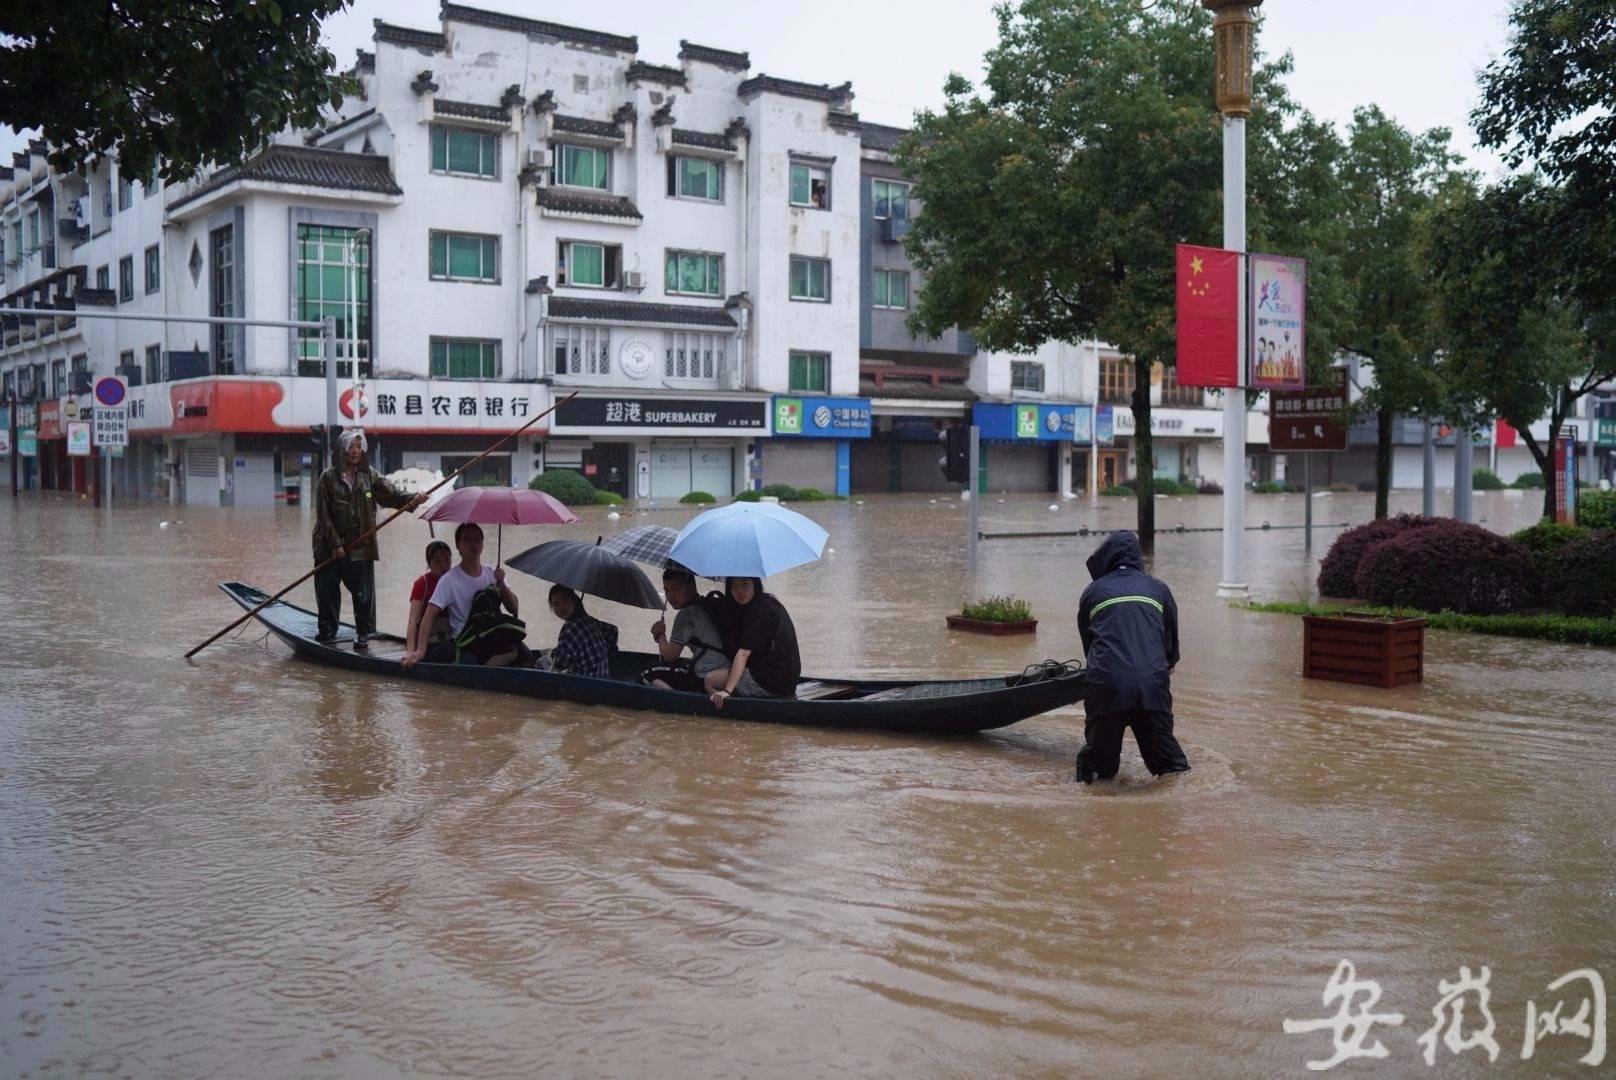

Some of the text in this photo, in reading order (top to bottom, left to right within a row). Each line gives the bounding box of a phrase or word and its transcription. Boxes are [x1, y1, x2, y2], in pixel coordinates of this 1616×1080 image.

[377, 394, 529, 417] 歙县农商银行
[97, 410, 125, 420] 区域内部
[606, 402, 641, 423] 超港
[645, 411, 717, 424] SUPERBAKERY
[834, 408, 869, 420] 中国移动
[97, 422, 125, 431] 除泊位外
[98, 433, 125, 443] 禁止停车
